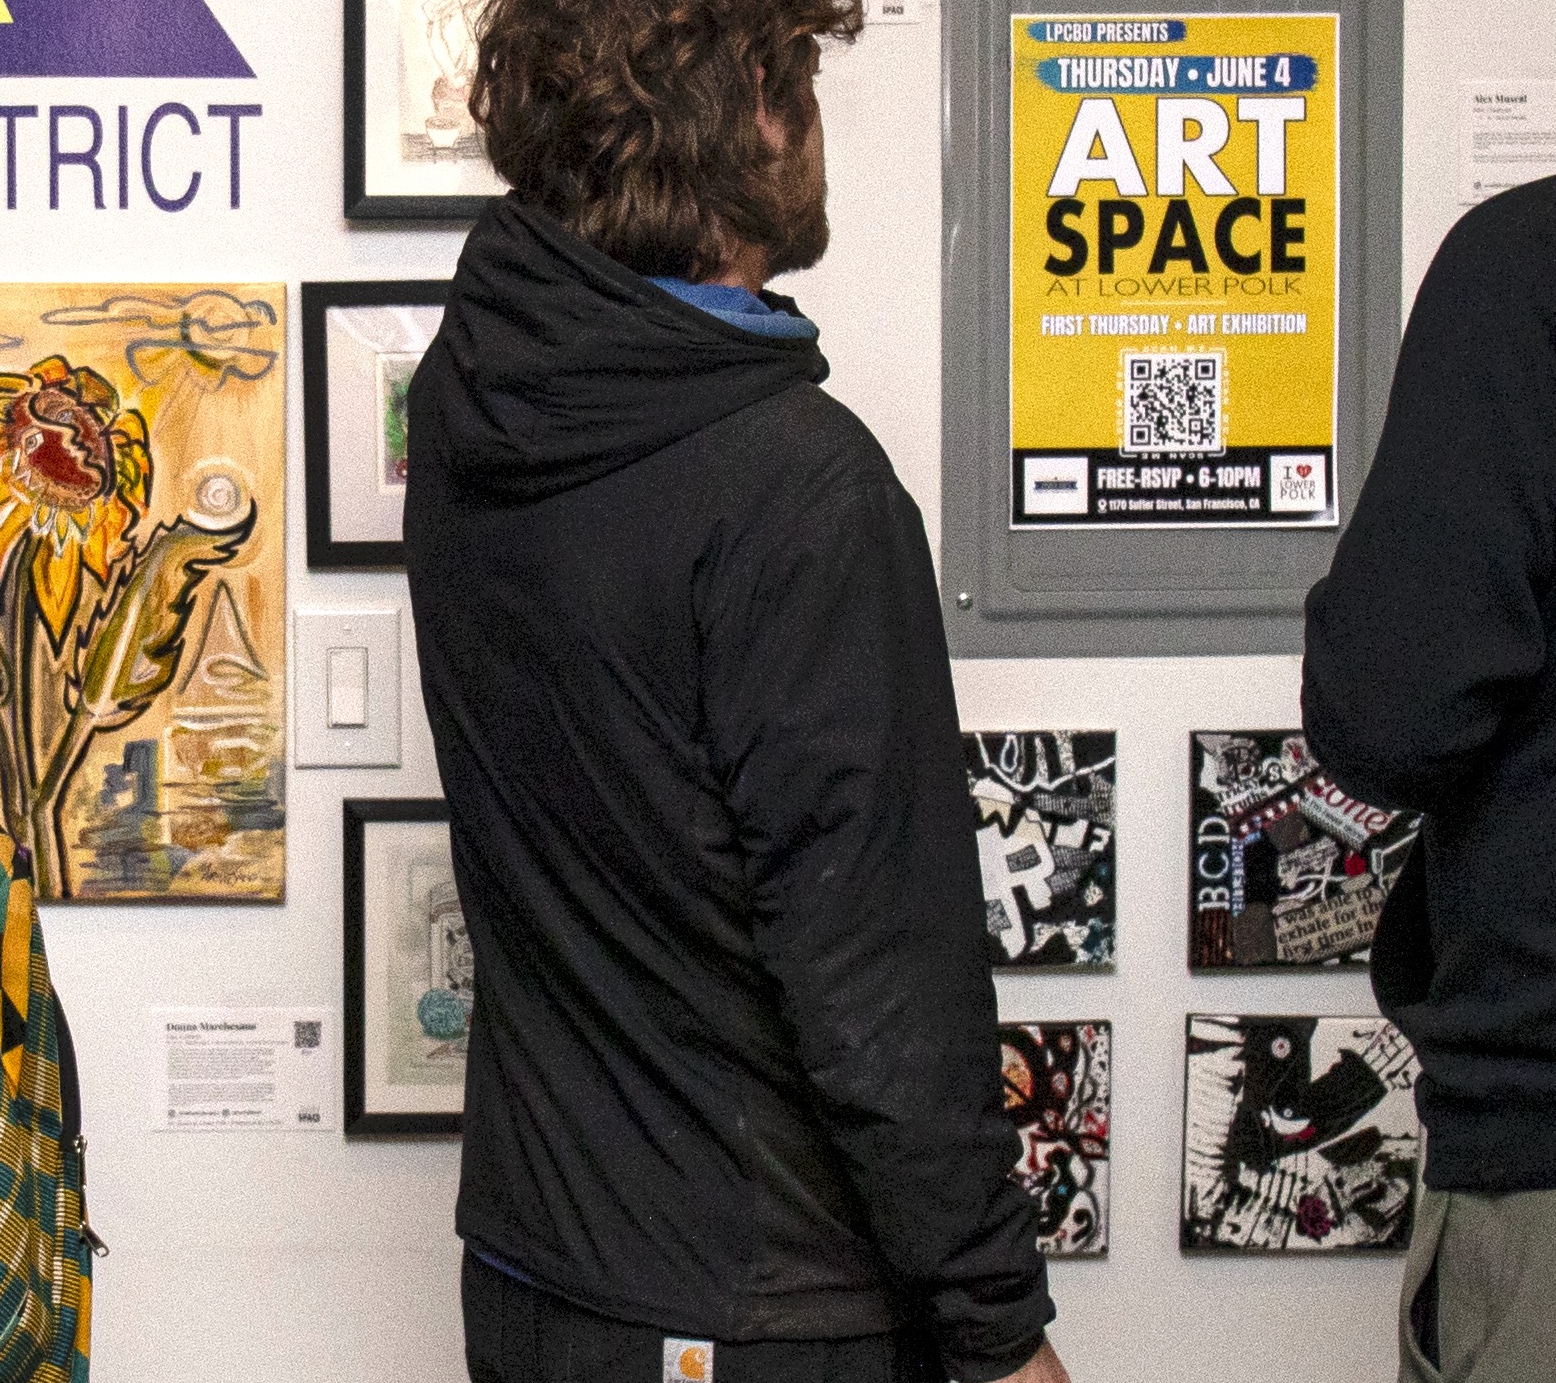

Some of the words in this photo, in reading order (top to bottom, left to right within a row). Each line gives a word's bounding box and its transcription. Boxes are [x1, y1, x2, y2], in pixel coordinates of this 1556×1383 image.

[1046, 23, 1092, 42] LPCBD
[1097, 22, 1169, 42] PRESENTS
[1058, 57, 1180, 89] THURSDAY
[1206, 57, 1267, 88] JUNE
[1274, 57, 1291, 87] 4
[1045, 96, 1307, 197] ART
[1044, 197, 1306, 277] SPACE
[1046, 278, 1089, 297] AT
[1099, 277, 1214, 297] LOWER
[1224, 276, 1302, 296] POLK
[1041, 314, 1084, 336] FIRST
[1089, 314, 1169, 336] THURSDAY
[1187, 314, 1218, 335] ART
[1221, 313, 1307, 334] EXHIBITION
[1097, 466, 1182, 489] FREE-RSVP
[1198, 466, 1261, 488] 6-10PM
[1283, 465, 1292, 480] I
[1109, 499, 1127, 511] 1170
[1186, 498, 1202, 510] San
[1249, 498, 1260, 510] CA
[1280, 488, 1316, 500] POLK
[1278, 917, 1331, 943] exhale
[1334, 907, 1358, 925] for
[1284, 907, 1315, 925] was
[1317, 927, 1354, 949] time
[1356, 918, 1374, 934] in
